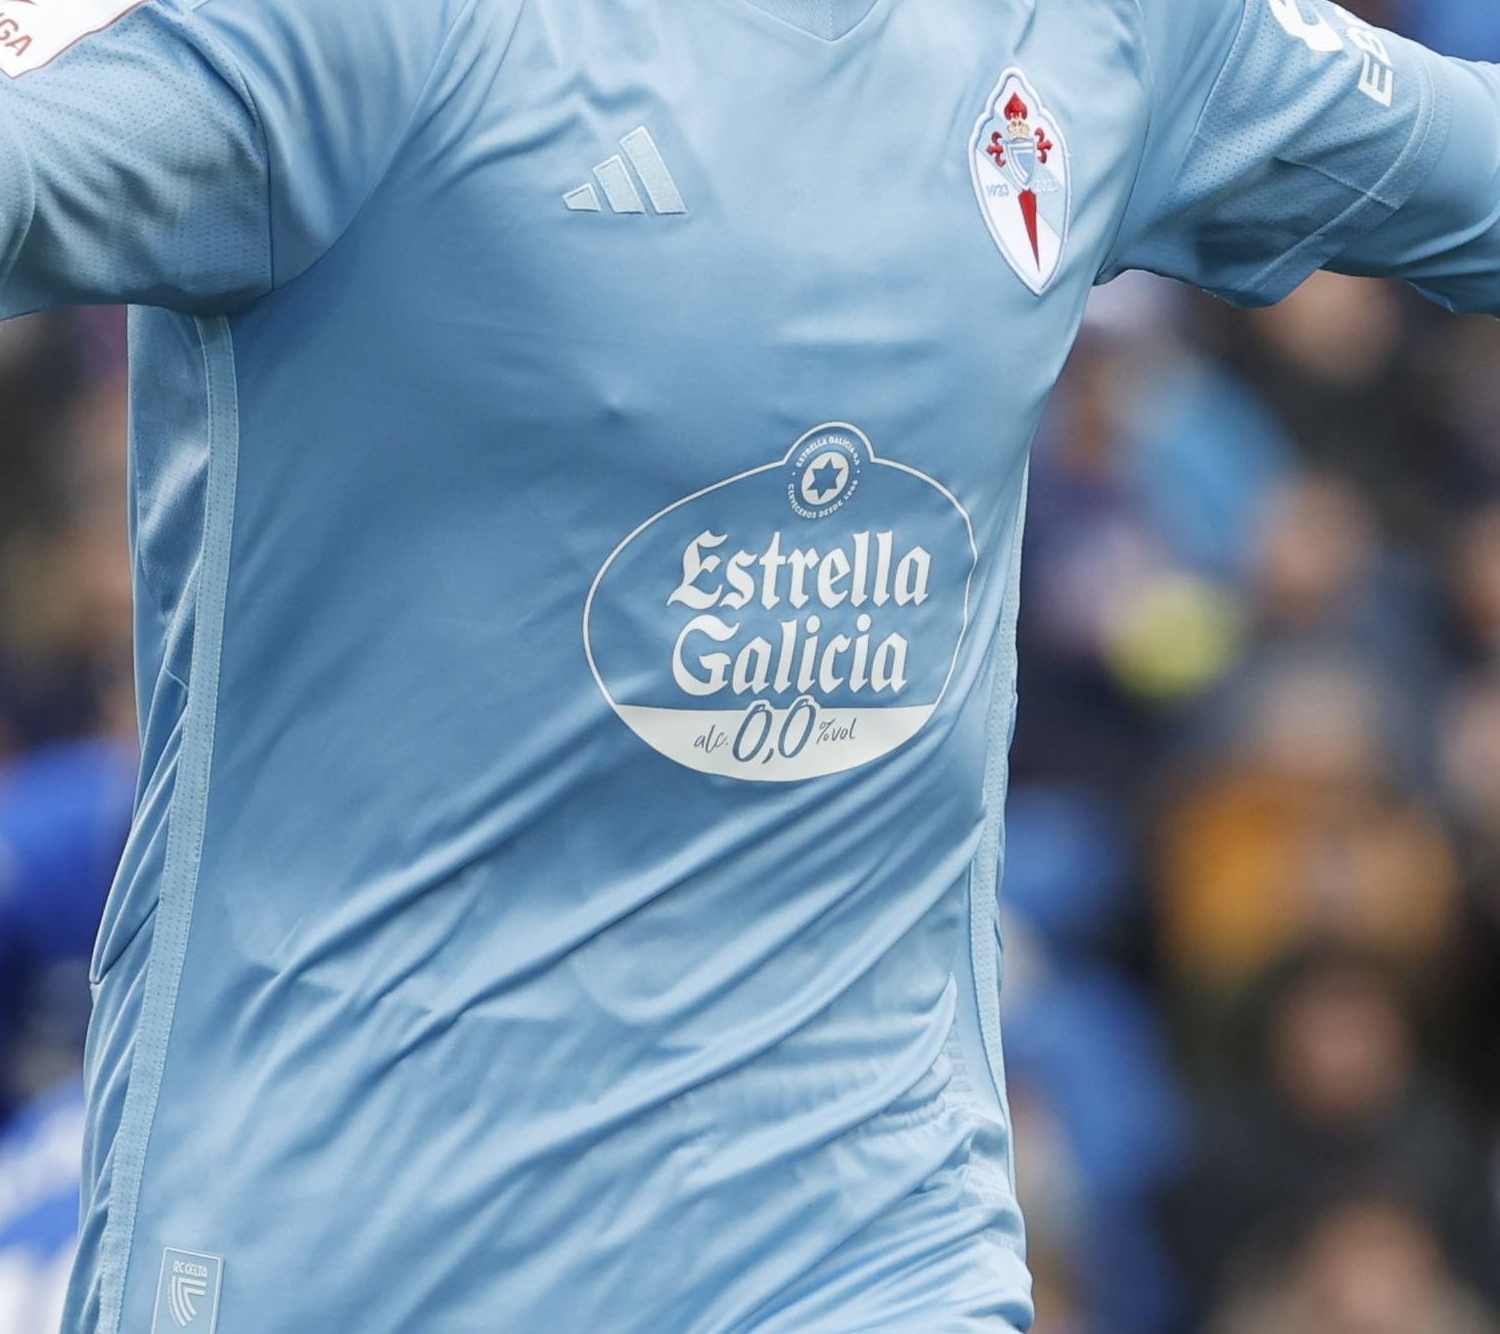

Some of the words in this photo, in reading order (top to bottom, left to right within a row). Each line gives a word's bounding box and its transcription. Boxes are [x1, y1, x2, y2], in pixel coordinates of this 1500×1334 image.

[796, 438, 828, 467] ESTRELLA
[828, 436, 855, 454] GALICIA
[788, 483, 817, 519] CERVECEROS
[818, 499, 844, 518] DESDE
[667, 529, 932, 611] Estrella
[672, 613, 909, 697] Galicia
[732, 698, 817, 765] 0,0
